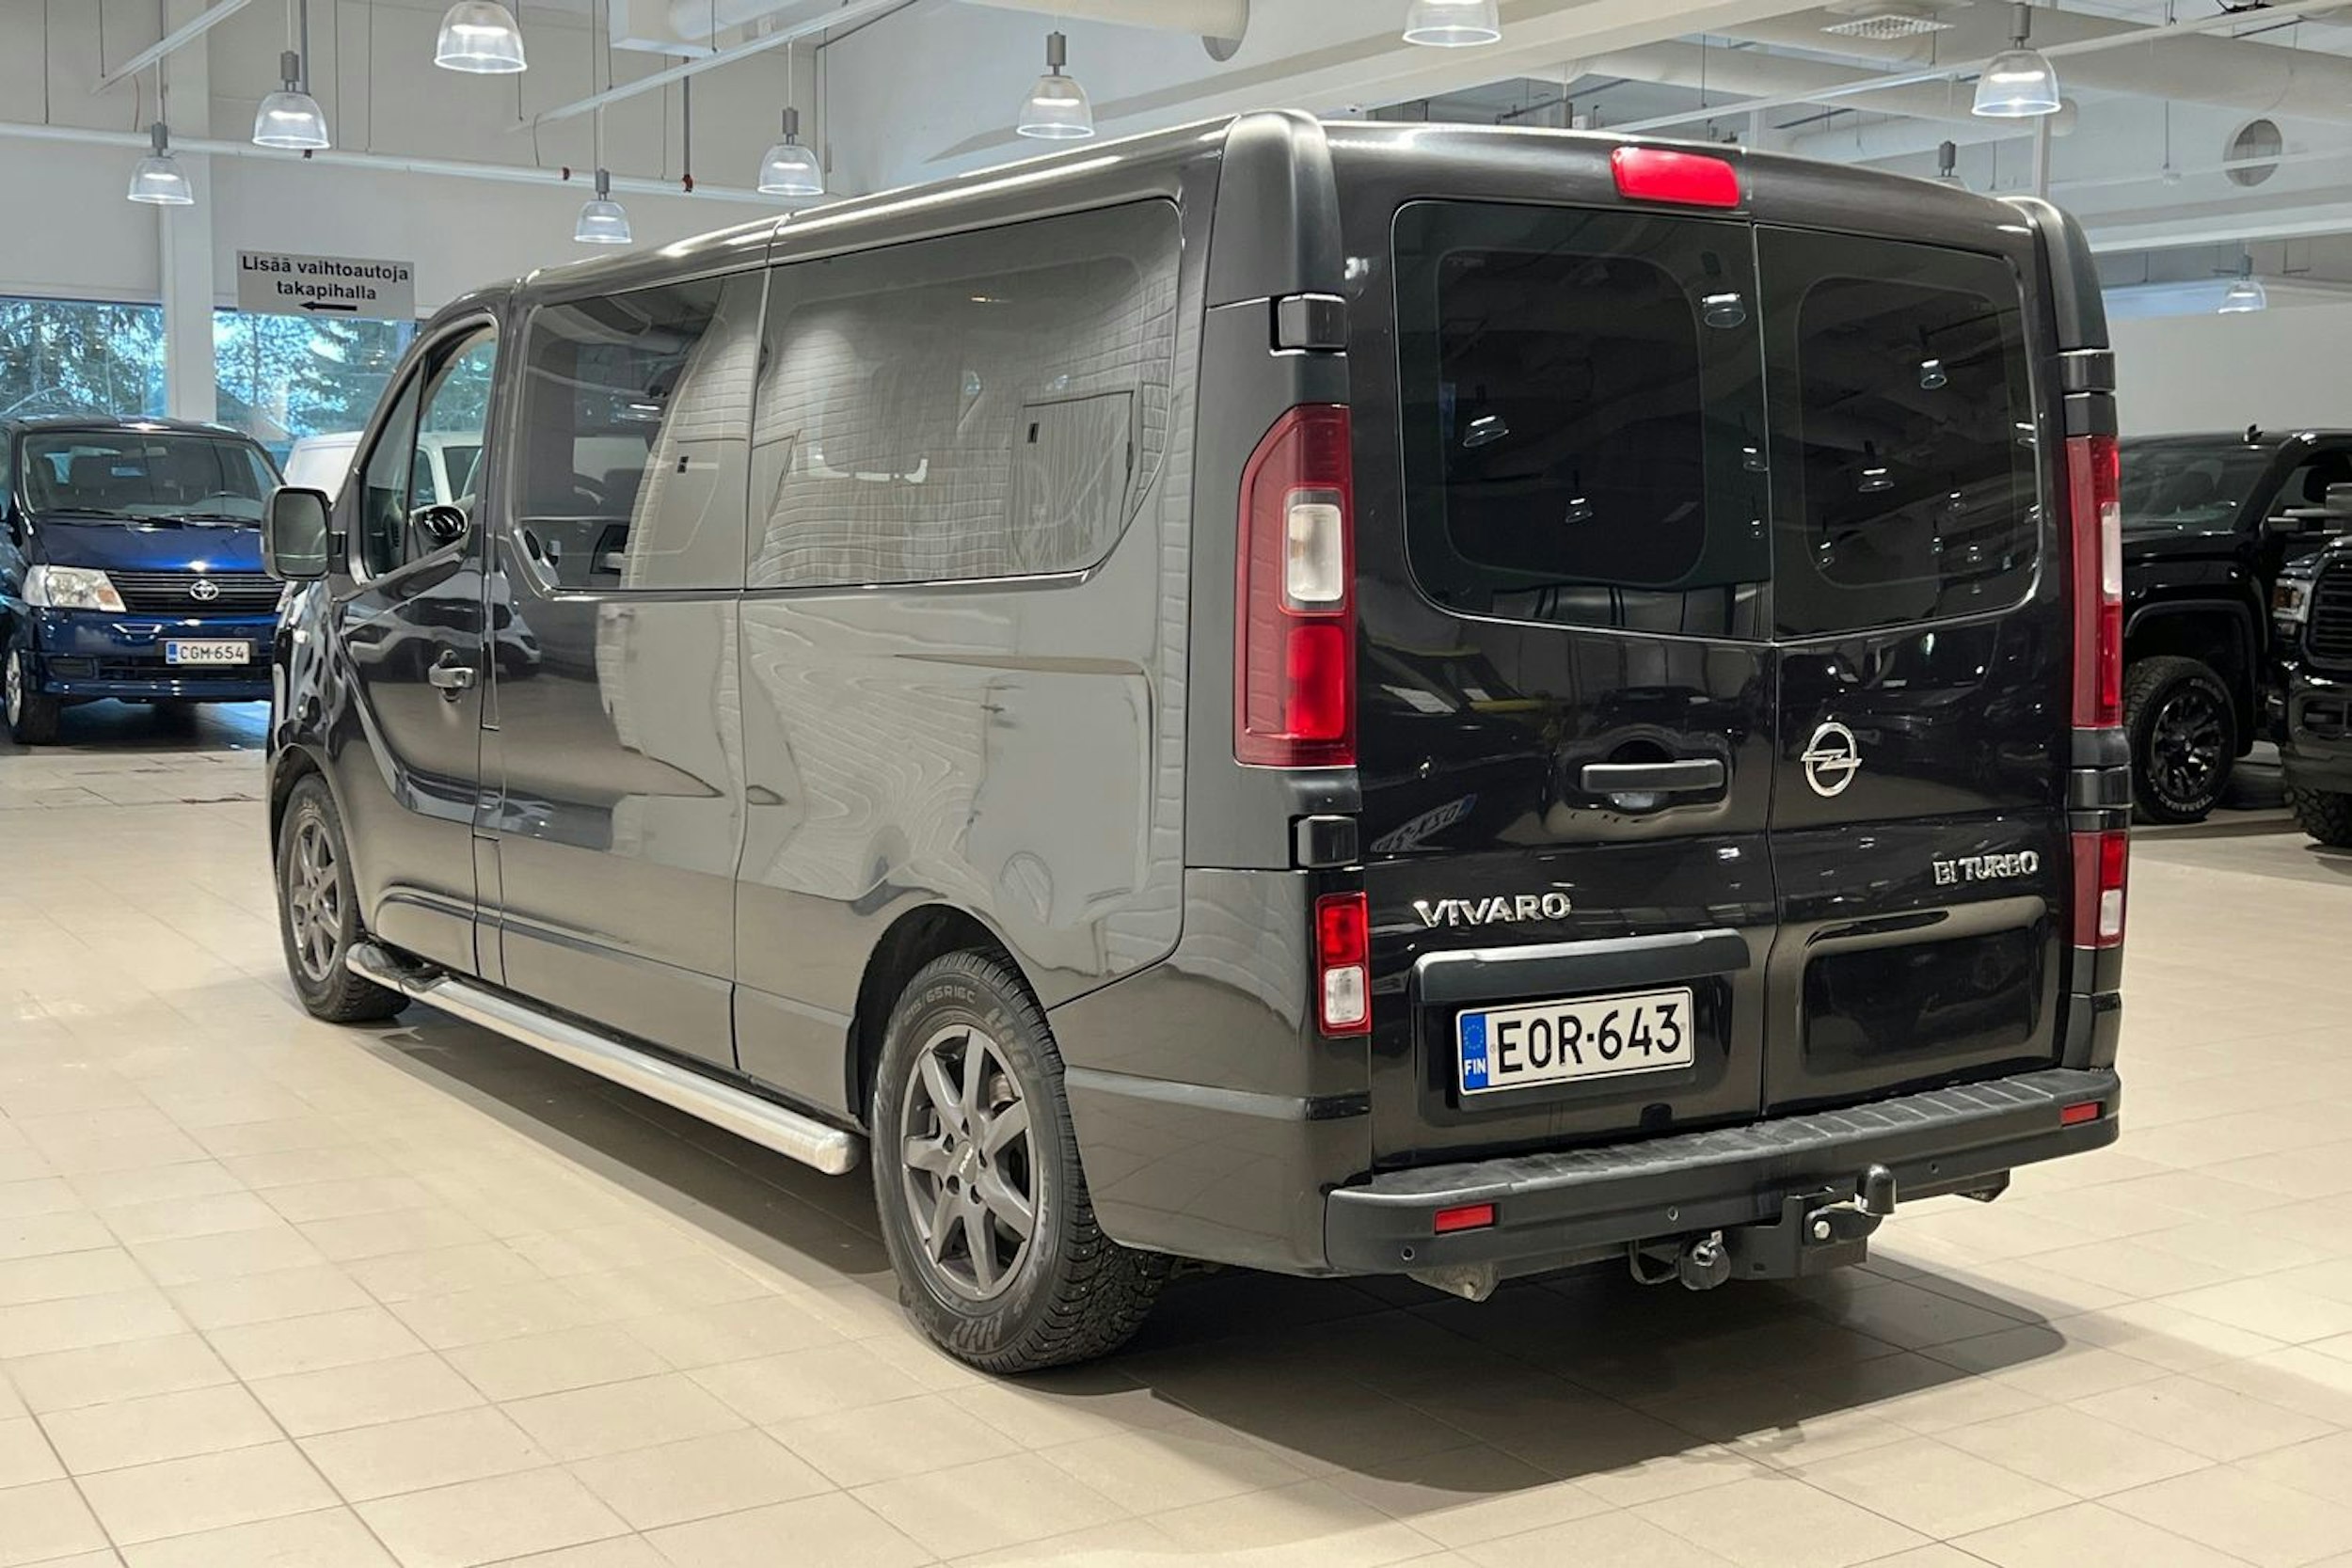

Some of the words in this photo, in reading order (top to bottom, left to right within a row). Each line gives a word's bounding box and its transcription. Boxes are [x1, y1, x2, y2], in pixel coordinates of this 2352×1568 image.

[243, 256, 291, 273] Lisää
[297, 261, 408, 282] vaihtoautoja
[277, 280, 376, 299] takapihalla
[1932, 860, 1958, 885] BI
[1958, 850, 2040, 879] TURBO
[1413, 892, 1572, 928] VIVARO
[1497, 1003, 1682, 1074] EOR-643
[1464, 1057, 1486, 1076] FIN
